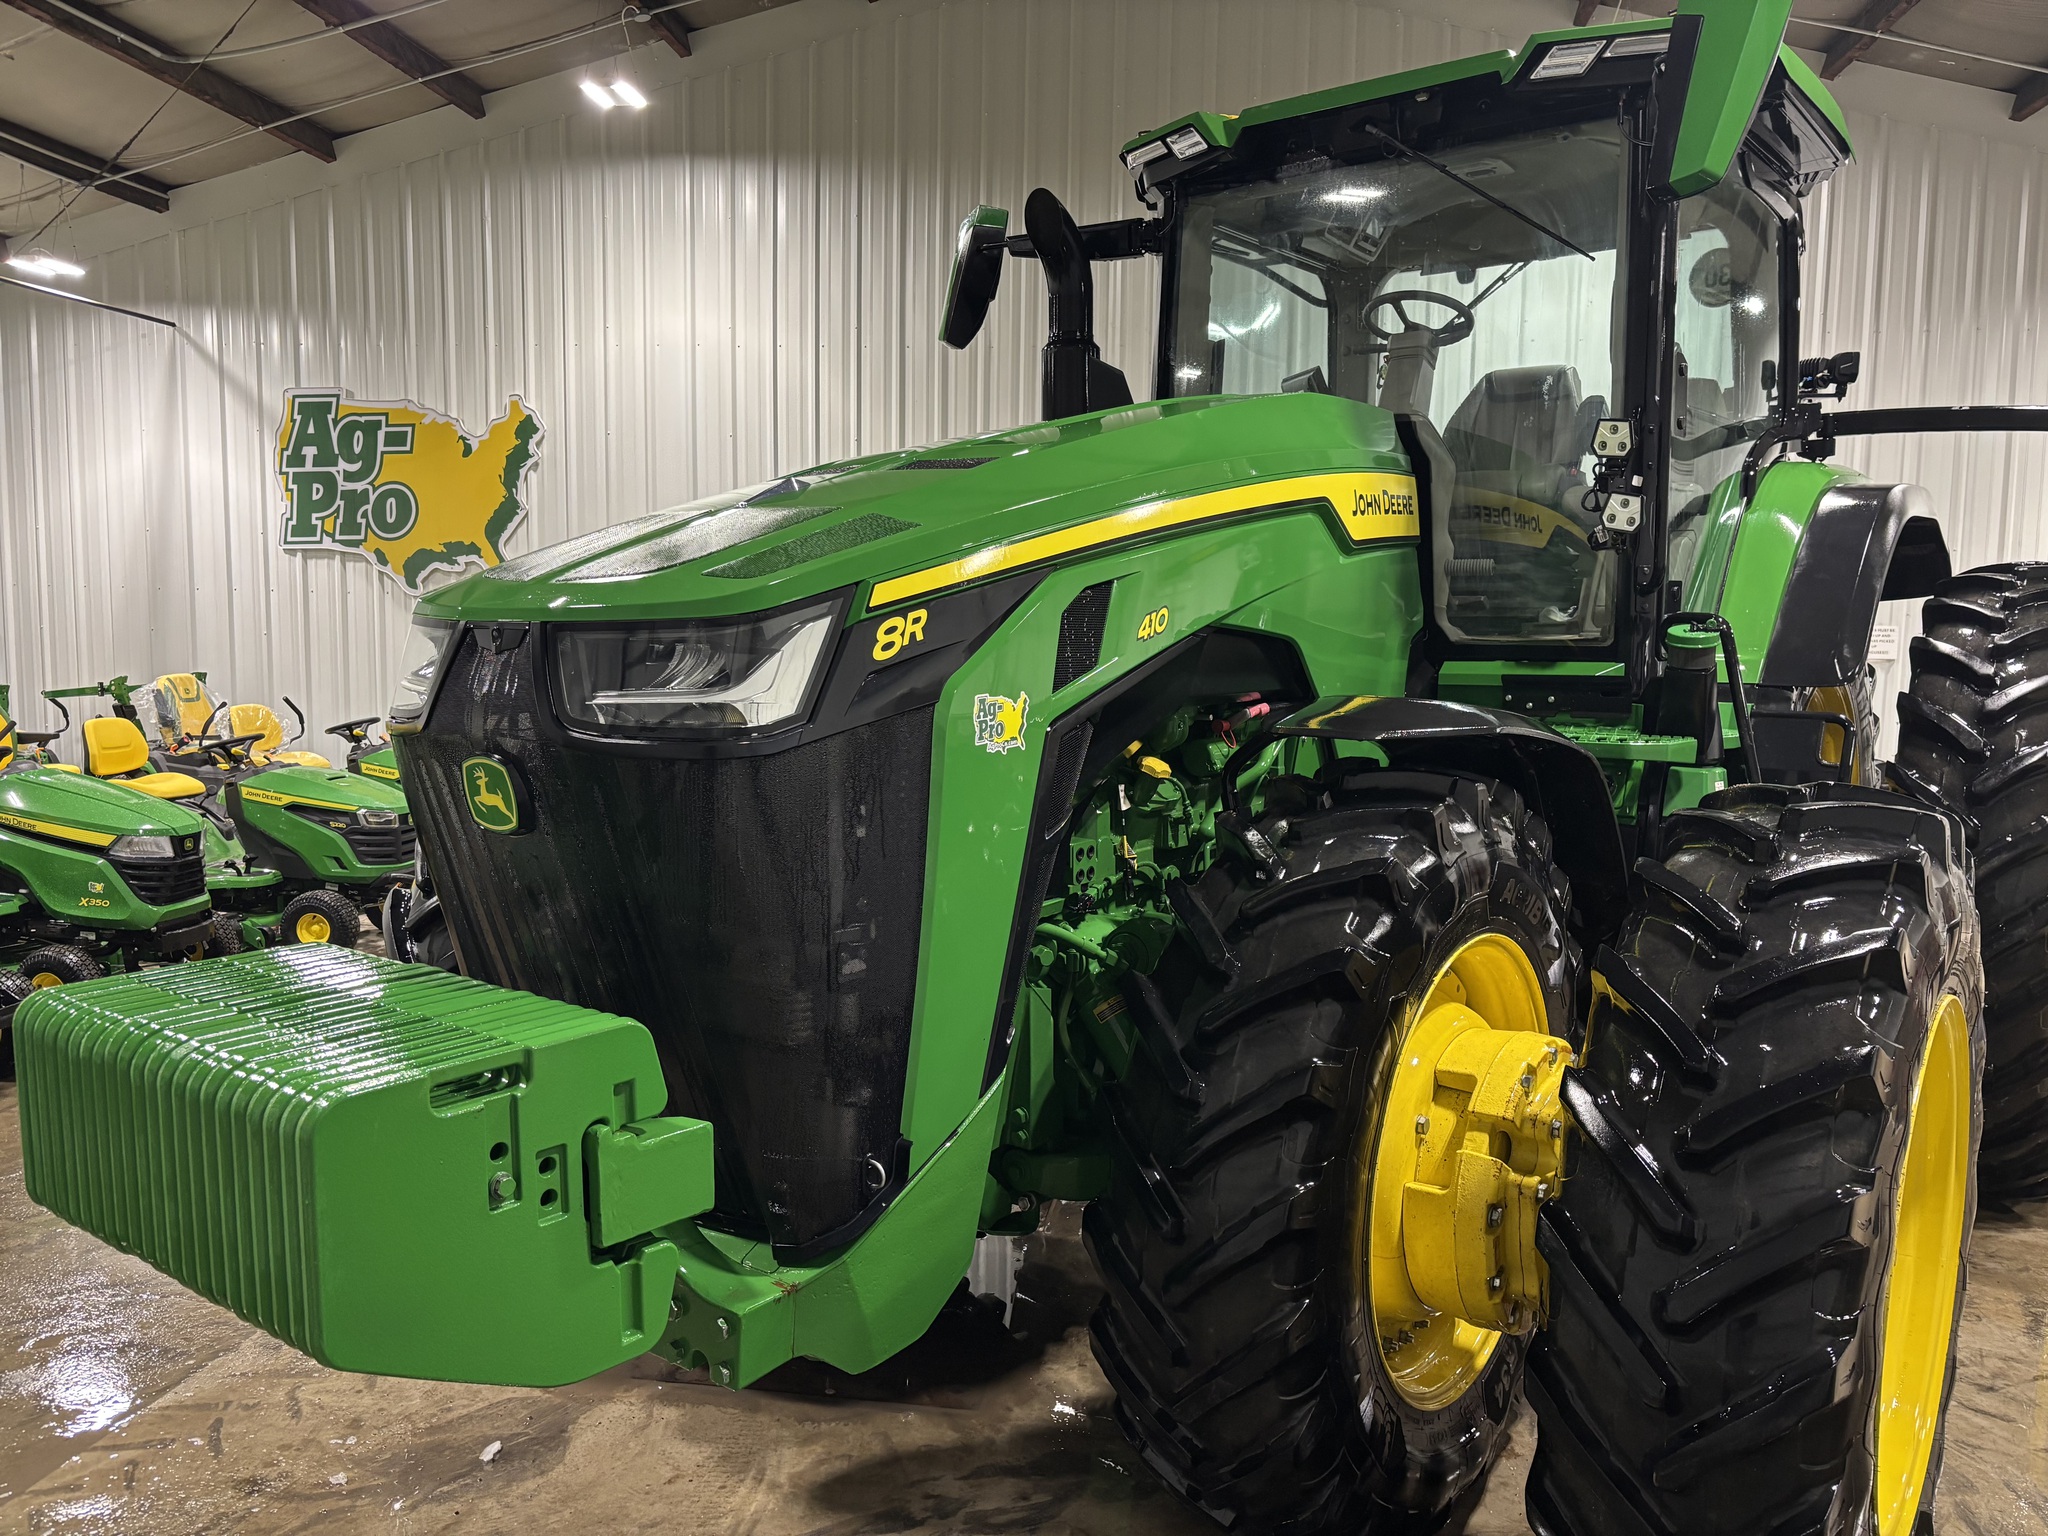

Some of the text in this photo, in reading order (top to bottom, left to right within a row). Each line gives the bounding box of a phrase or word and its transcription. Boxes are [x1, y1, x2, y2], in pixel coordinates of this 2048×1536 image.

[281, 395, 415, 485] Ag-
[284, 469, 418, 544] Pro
[1352, 489, 1414, 517] JOHN DEERE
[872, 608, 928, 661] 8R
[1136, 605, 1169, 642] 410
[976, 696, 1003, 722] Ag-
[977, 720, 1004, 742] Pro
[245, 790, 283, 802] JOHN DEERE
[13, 817, 37, 830] DEERE
[78, 896, 110, 907] X350
